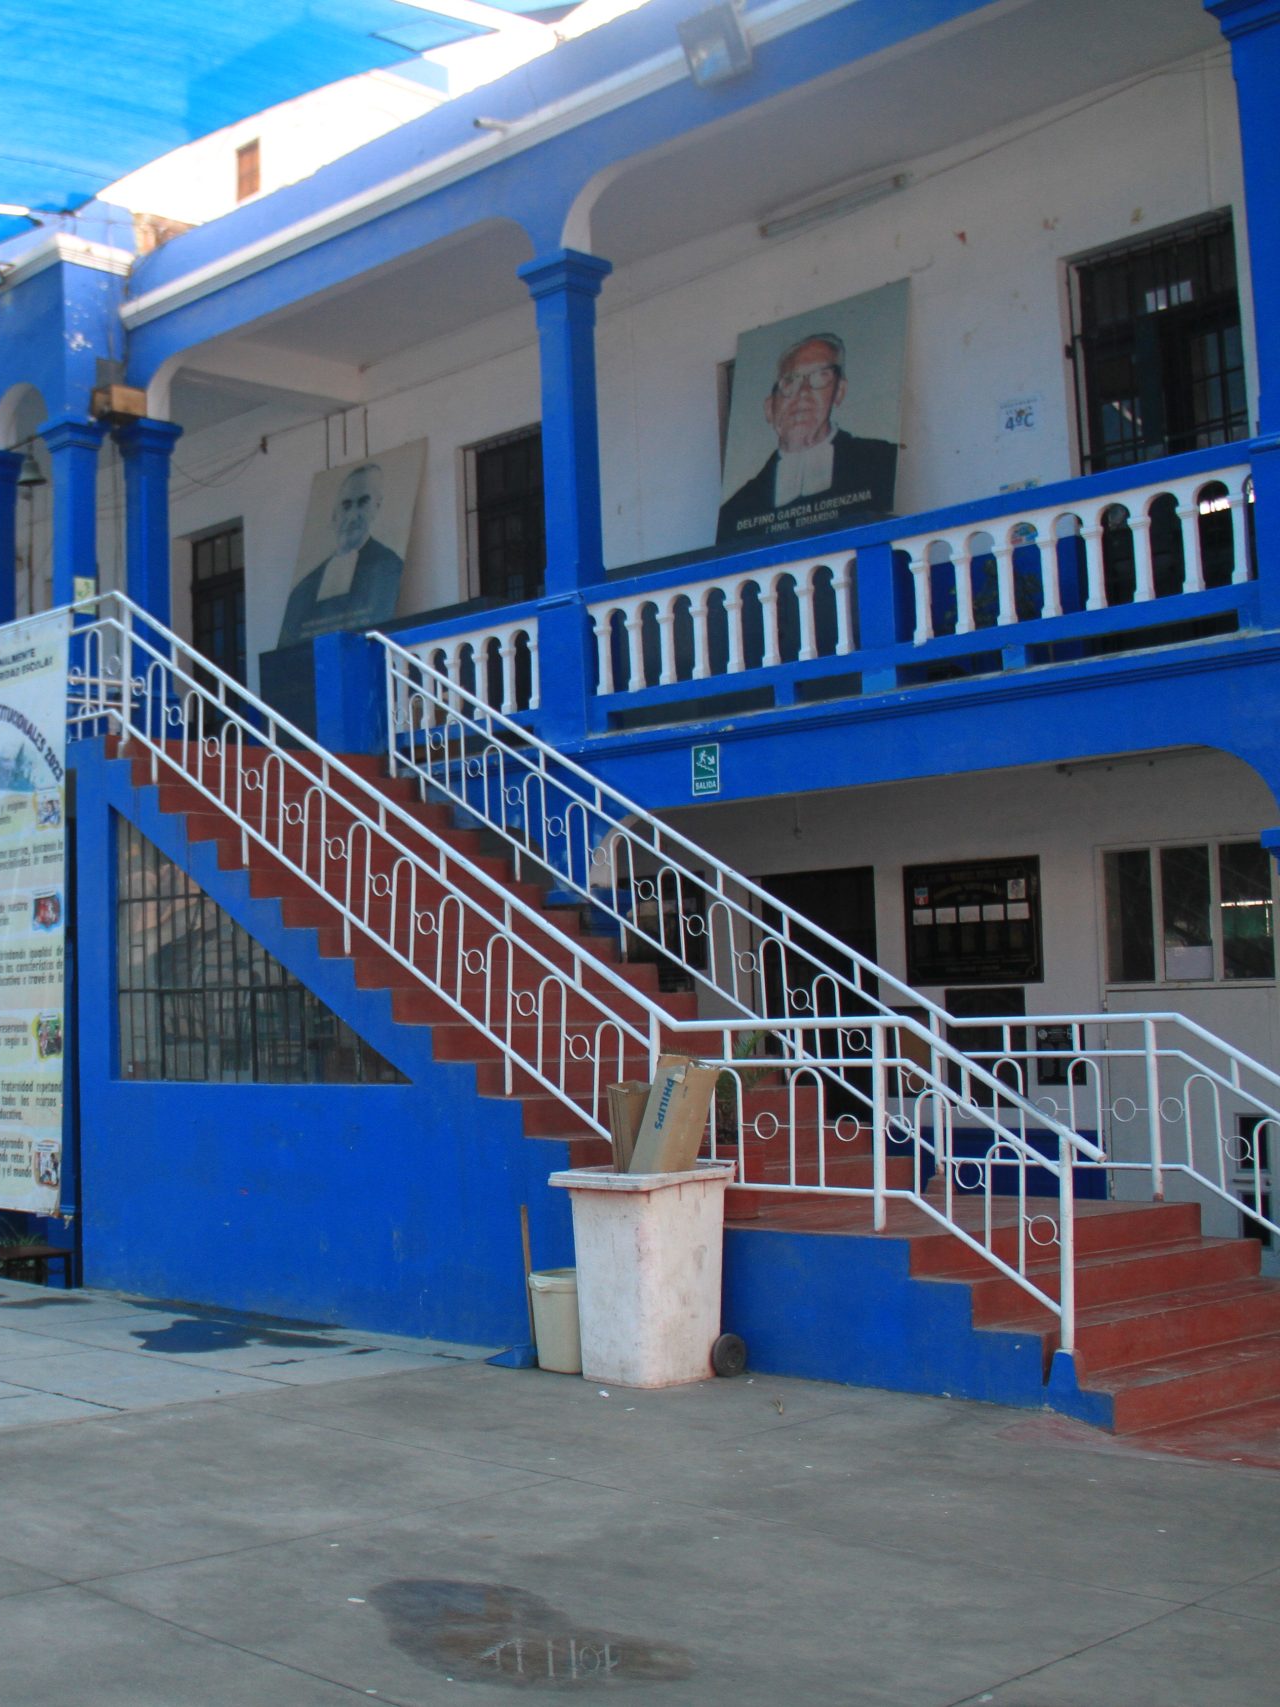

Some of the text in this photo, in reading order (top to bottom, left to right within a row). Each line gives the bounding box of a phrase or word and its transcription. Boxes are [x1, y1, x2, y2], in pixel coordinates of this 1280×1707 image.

[736, 489, 873, 531] DELFINO GARCIA LORENZANA
[695, 780, 717, 791] SALIDA
[654, 1078, 675, 1131] PHILIPS
